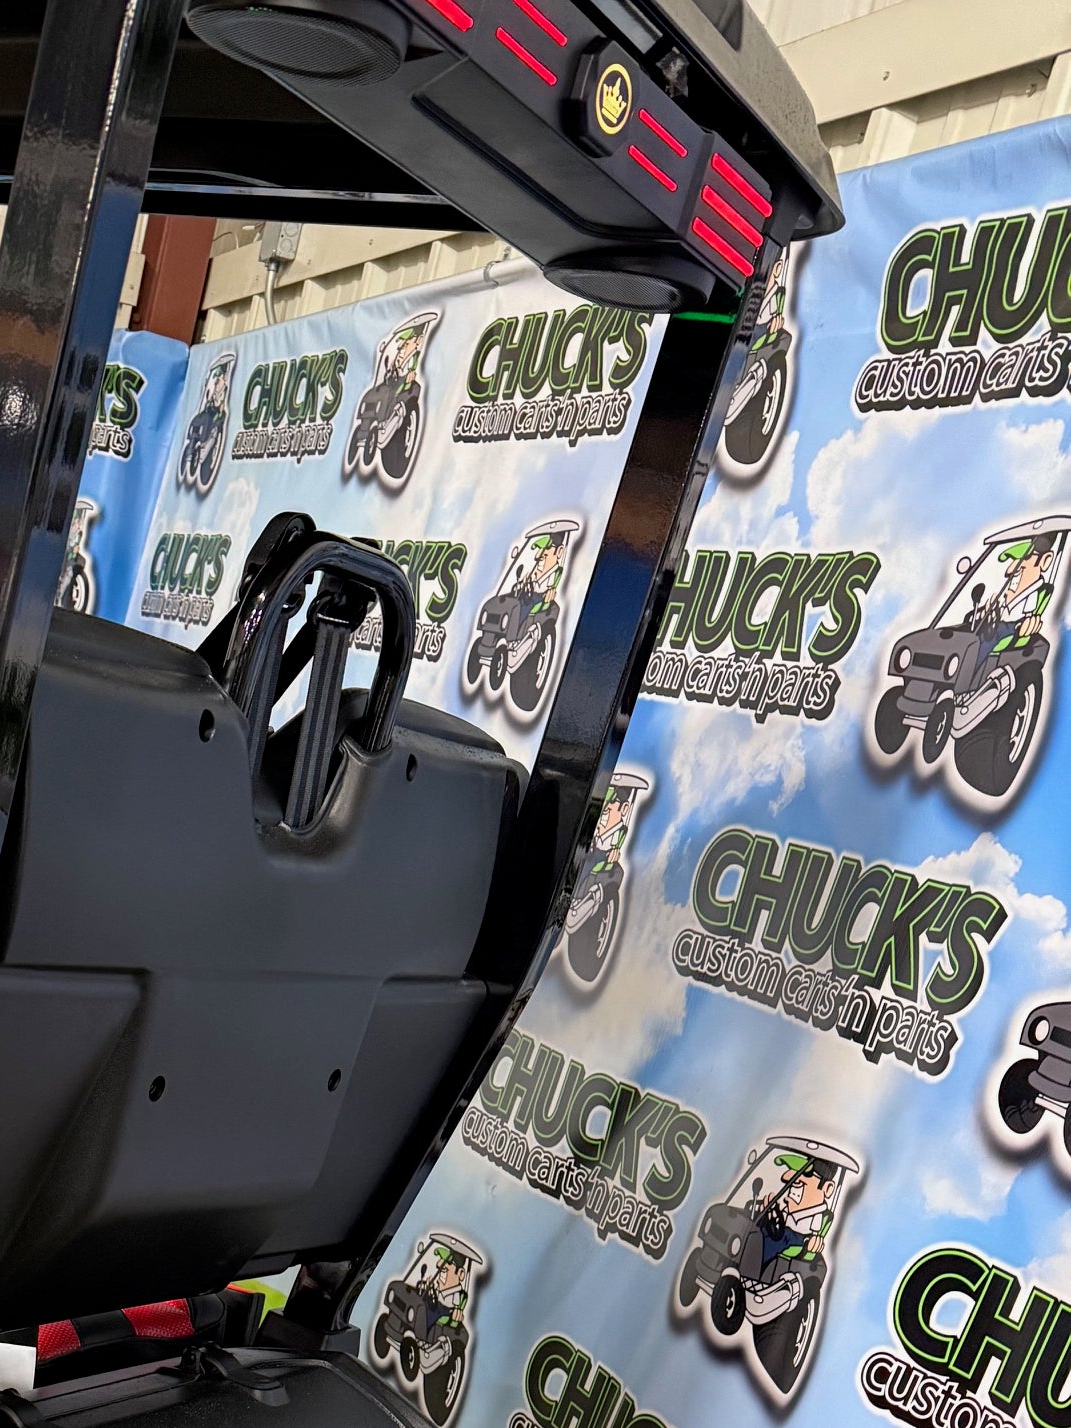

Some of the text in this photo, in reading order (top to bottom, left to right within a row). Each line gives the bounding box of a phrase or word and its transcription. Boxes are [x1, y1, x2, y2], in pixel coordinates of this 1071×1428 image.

[243, 349, 348, 430] CHUCK'S
[466, 304, 653, 404] CHUCK'S
[855, 332, 1071, 413] custom carts
[452, 403, 516, 443] custom
[570, 392, 631, 447] parts
[149, 532, 232, 597] CHUCK'S
[657, 550, 881, 665] HUCK'S
[756, 660, 841, 724] parts
[693, 828, 1008, 1016] CHUCK'S
[672, 929, 786, 1008] custom
[863, 996, 958, 1077] parts
[479, 1028, 707, 1211] CHUCK'S
[461, 1106, 530, 1181] custom
[597, 1184, 673, 1260] parts
